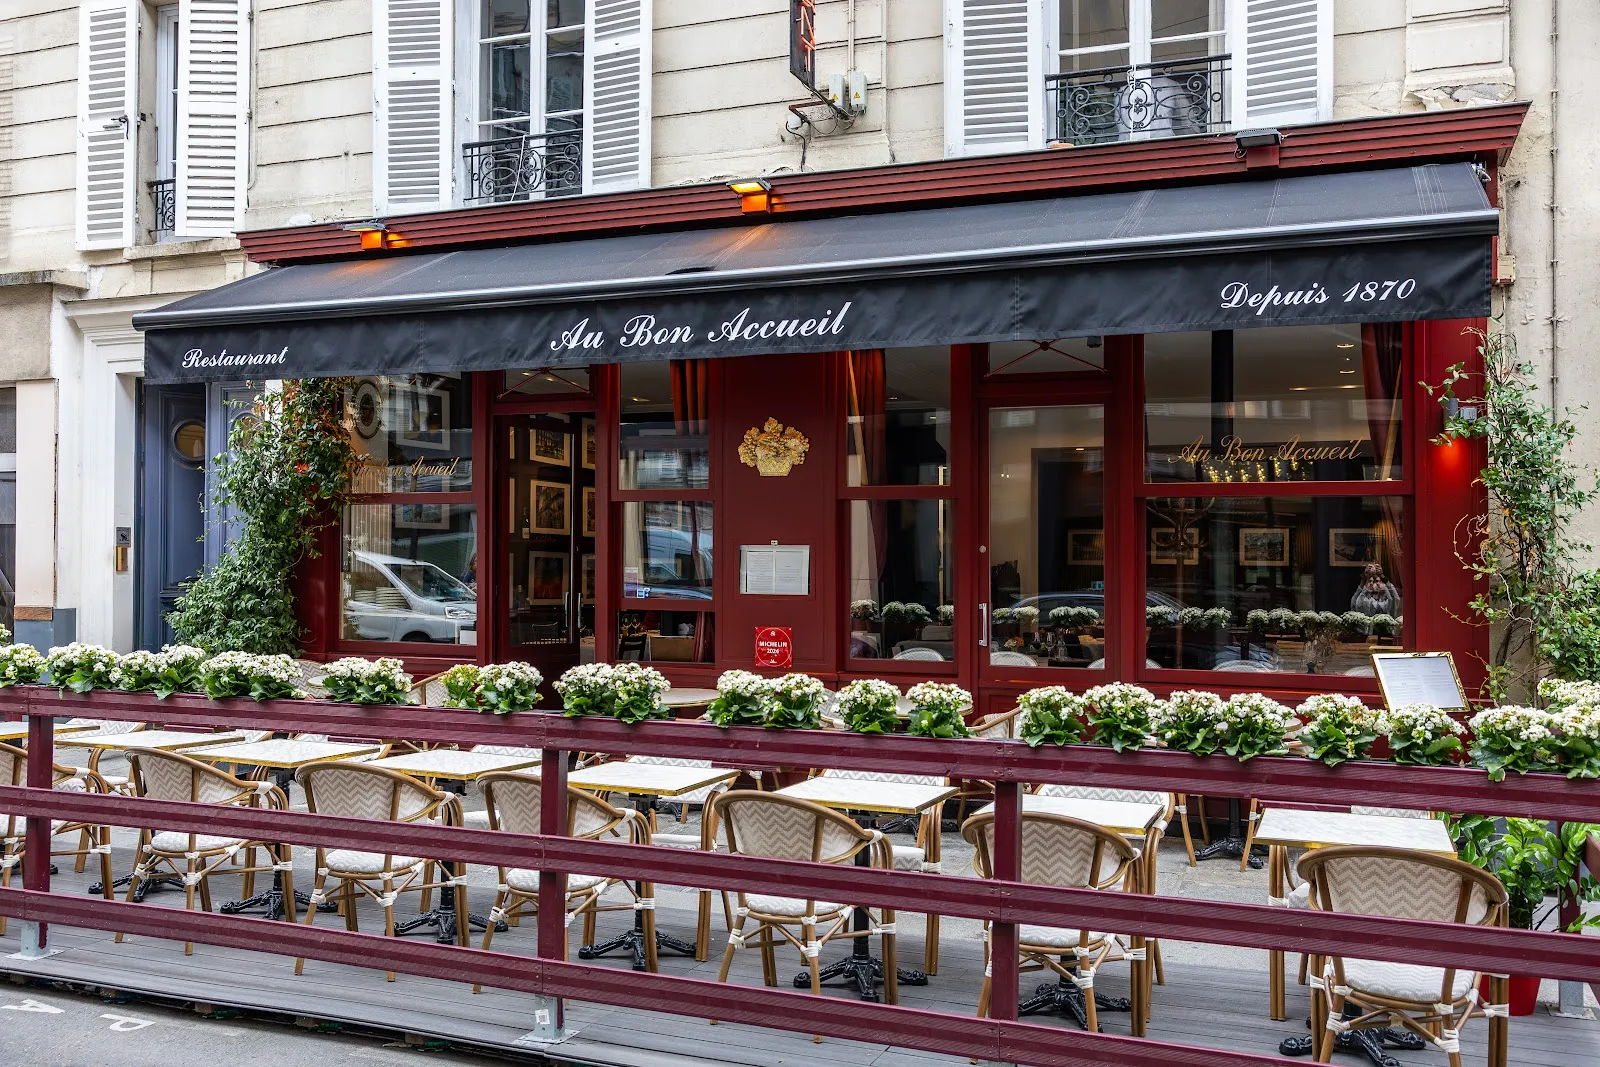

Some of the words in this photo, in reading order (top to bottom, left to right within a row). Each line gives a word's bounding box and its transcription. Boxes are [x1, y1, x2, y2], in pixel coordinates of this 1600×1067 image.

[1220, 281, 1330, 316] Depuis
[1342, 278, 1416, 303] 1870
[550, 317, 605, 351] Au
[619, 314, 695, 347] Bon
[707, 301, 852, 342] Accueil
[181, 346, 289, 369] Restaurant
[1168, 434, 1211, 464] Au
[1215, 433, 1268, 462] Bon
[1269, 433, 1364, 462] Accueil
[405, 455, 460, 477] Accueil
